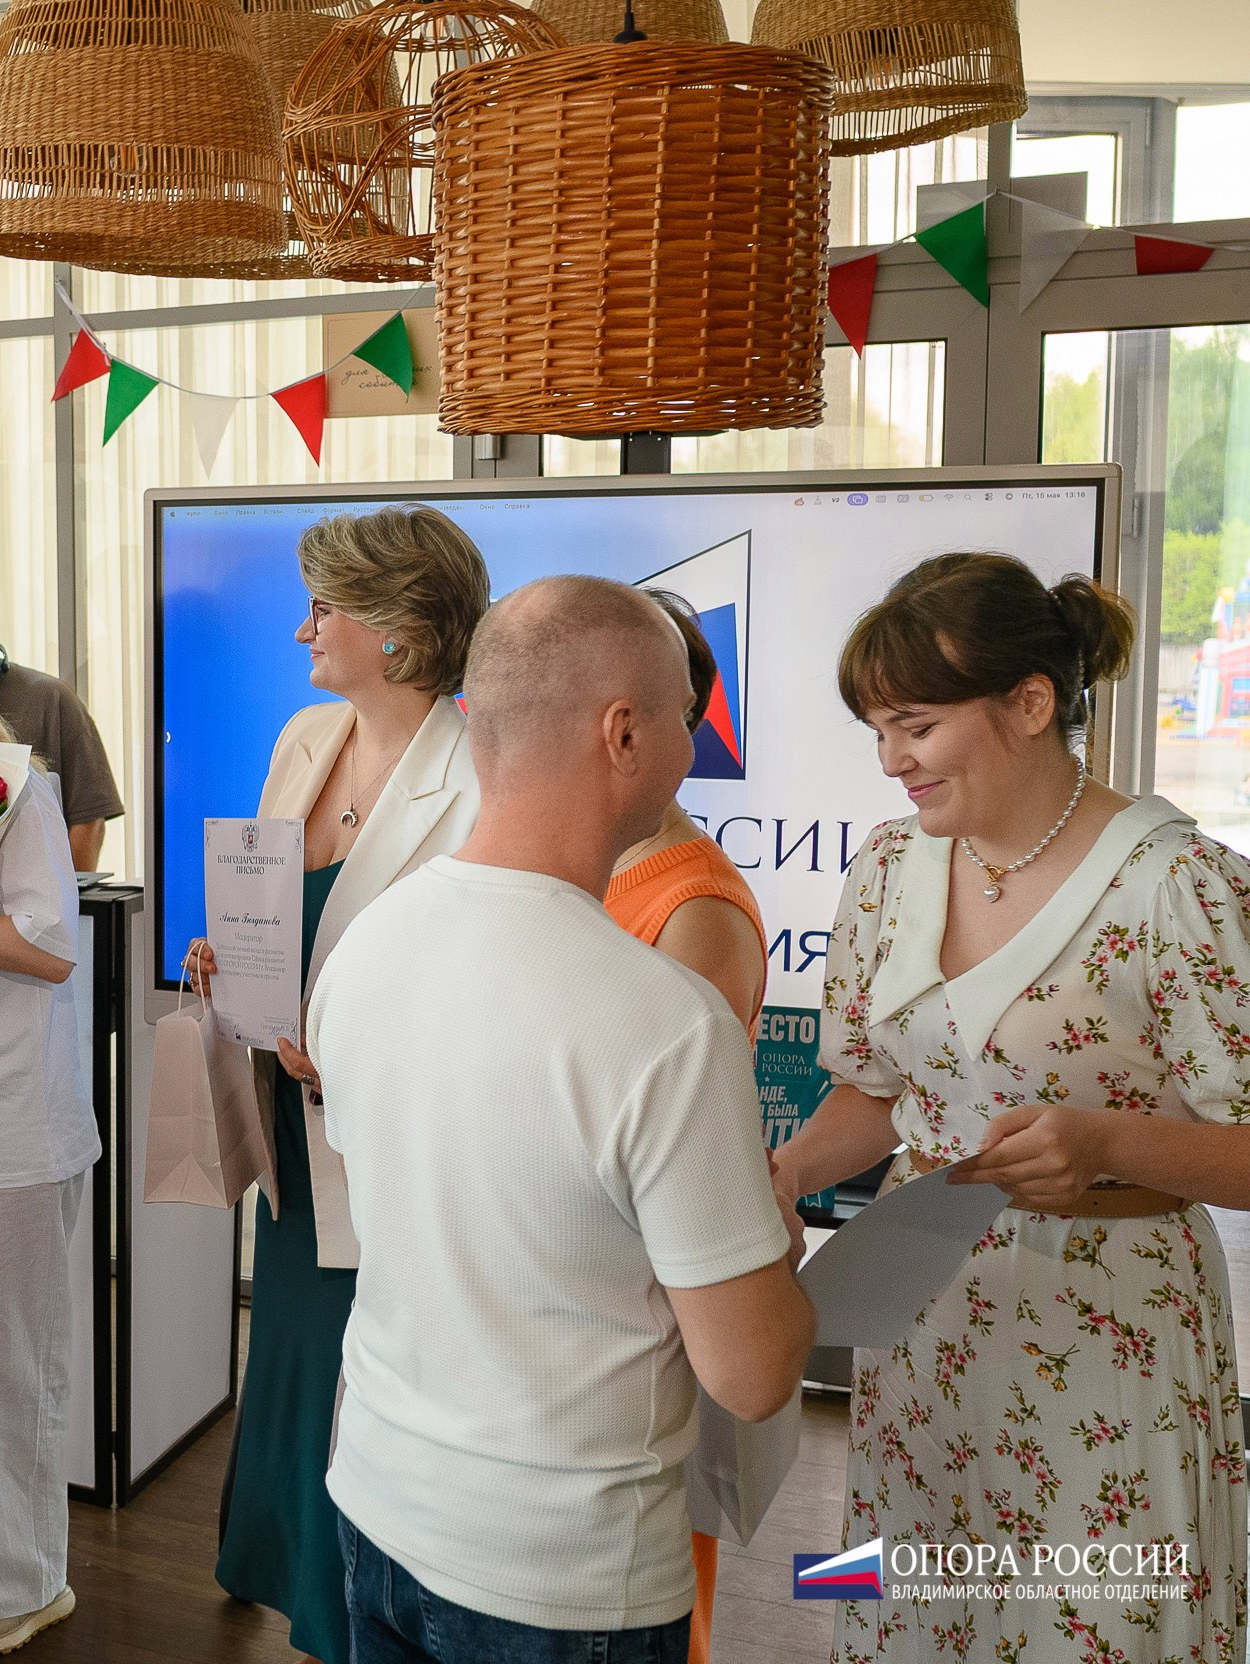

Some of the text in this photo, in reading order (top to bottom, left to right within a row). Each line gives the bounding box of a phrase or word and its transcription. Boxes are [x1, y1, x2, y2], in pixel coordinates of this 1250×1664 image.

[217, 854, 286, 866] БЛАГОДАРСТВЕННОЕ
[235, 865, 265, 875] ПИСЬМО
[762, 1052, 805, 1065] ОПОРА
[762, 1063, 813, 1076] РОССИИ
[758, 1085, 788, 1104] НДЕ,
[767, 1104, 799, 1117] БЫЛА
